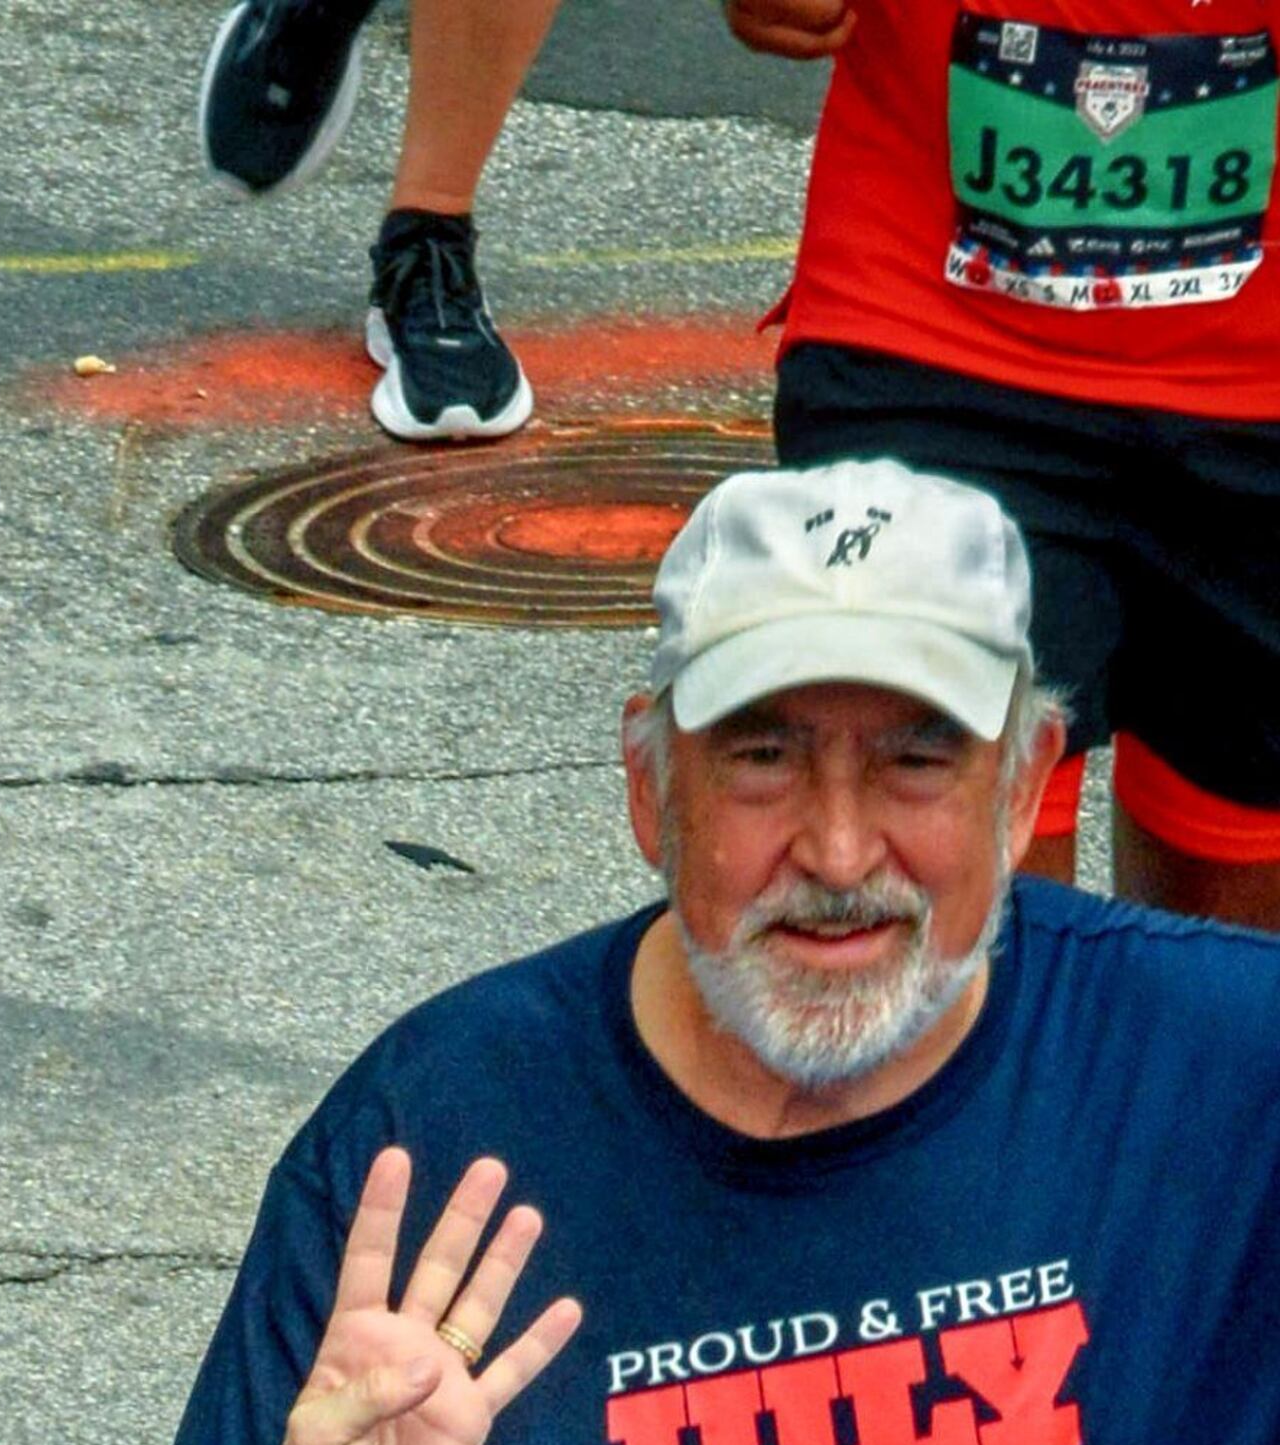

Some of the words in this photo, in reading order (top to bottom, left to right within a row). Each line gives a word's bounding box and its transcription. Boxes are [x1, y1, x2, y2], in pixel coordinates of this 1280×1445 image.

[963, 127, 1253, 210] J34318
[1218, 271, 1243, 293] 3X
[606, 1310, 839, 1394] PROUD
[857, 1300, 900, 1341] &
[916, 1258, 1075, 1330] FREE
